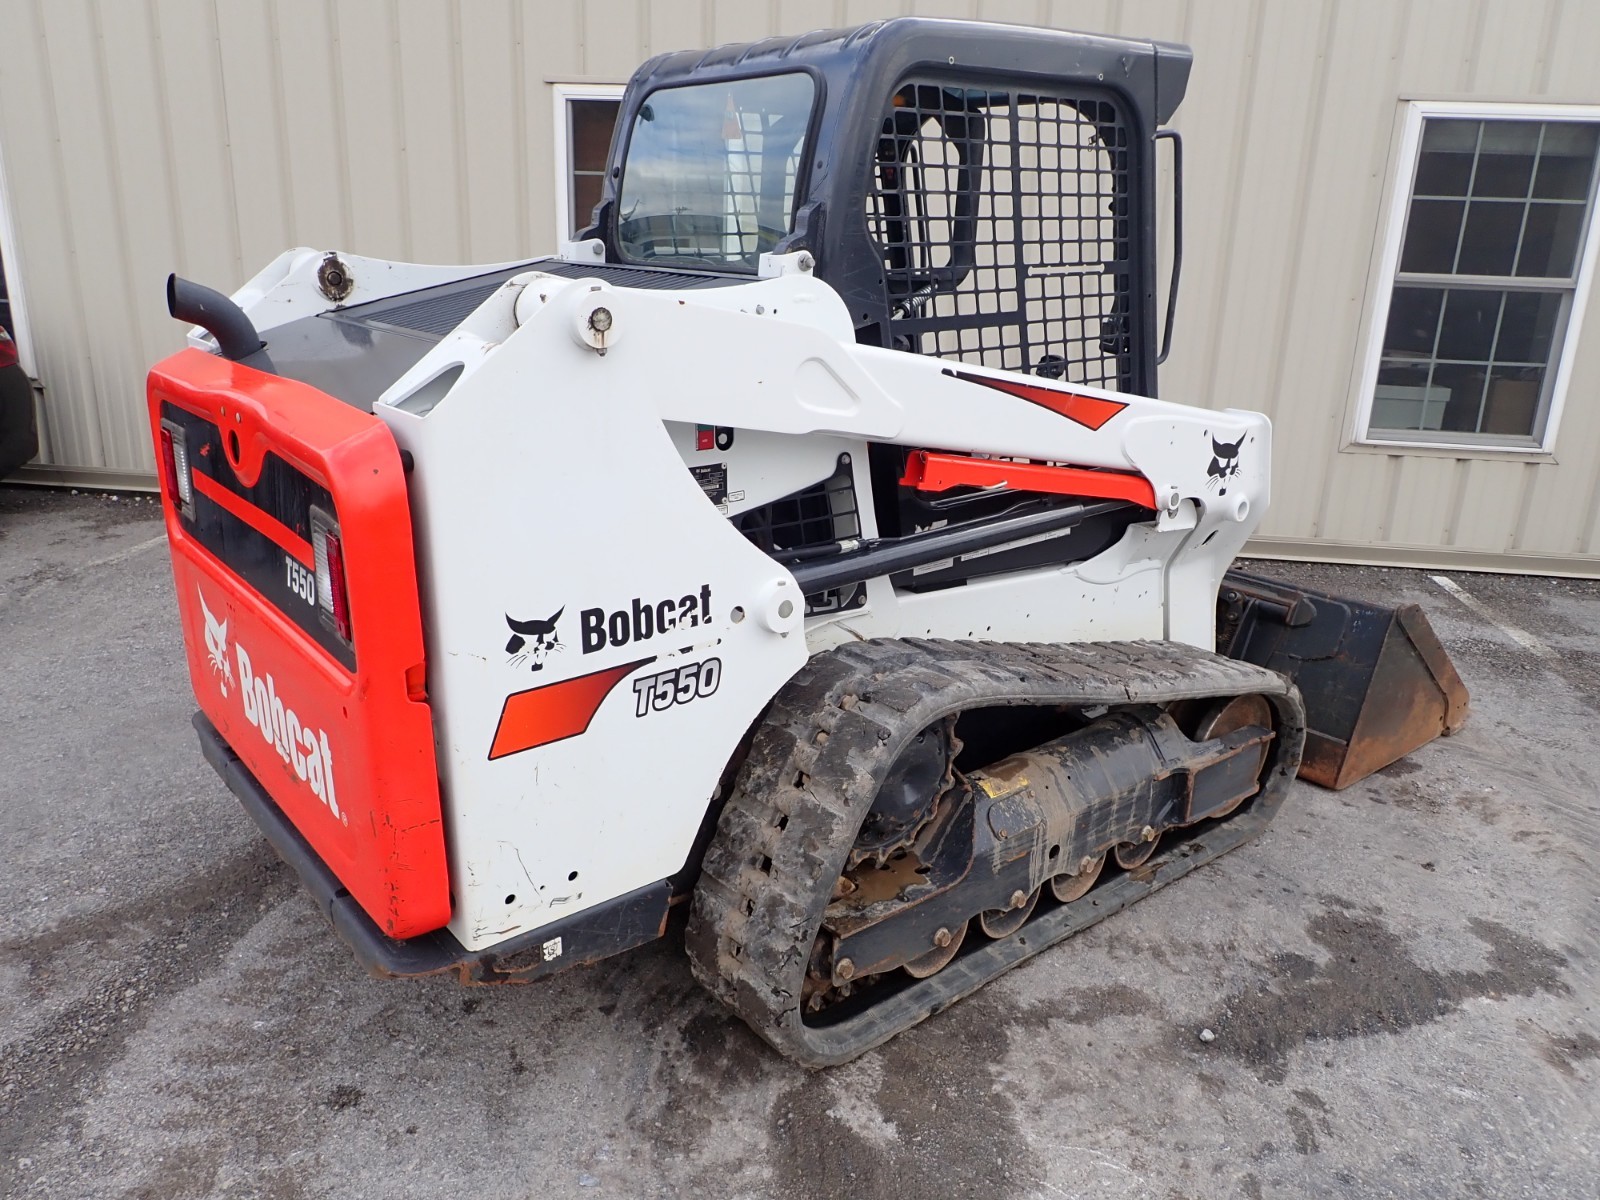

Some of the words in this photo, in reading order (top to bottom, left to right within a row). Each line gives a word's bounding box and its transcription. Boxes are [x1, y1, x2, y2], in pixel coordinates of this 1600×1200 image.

[285, 556, 315, 606] T550
[580, 584, 712, 655] Bobcat
[633, 657, 722, 717] T550
[235, 642, 340, 819] Bobcat
